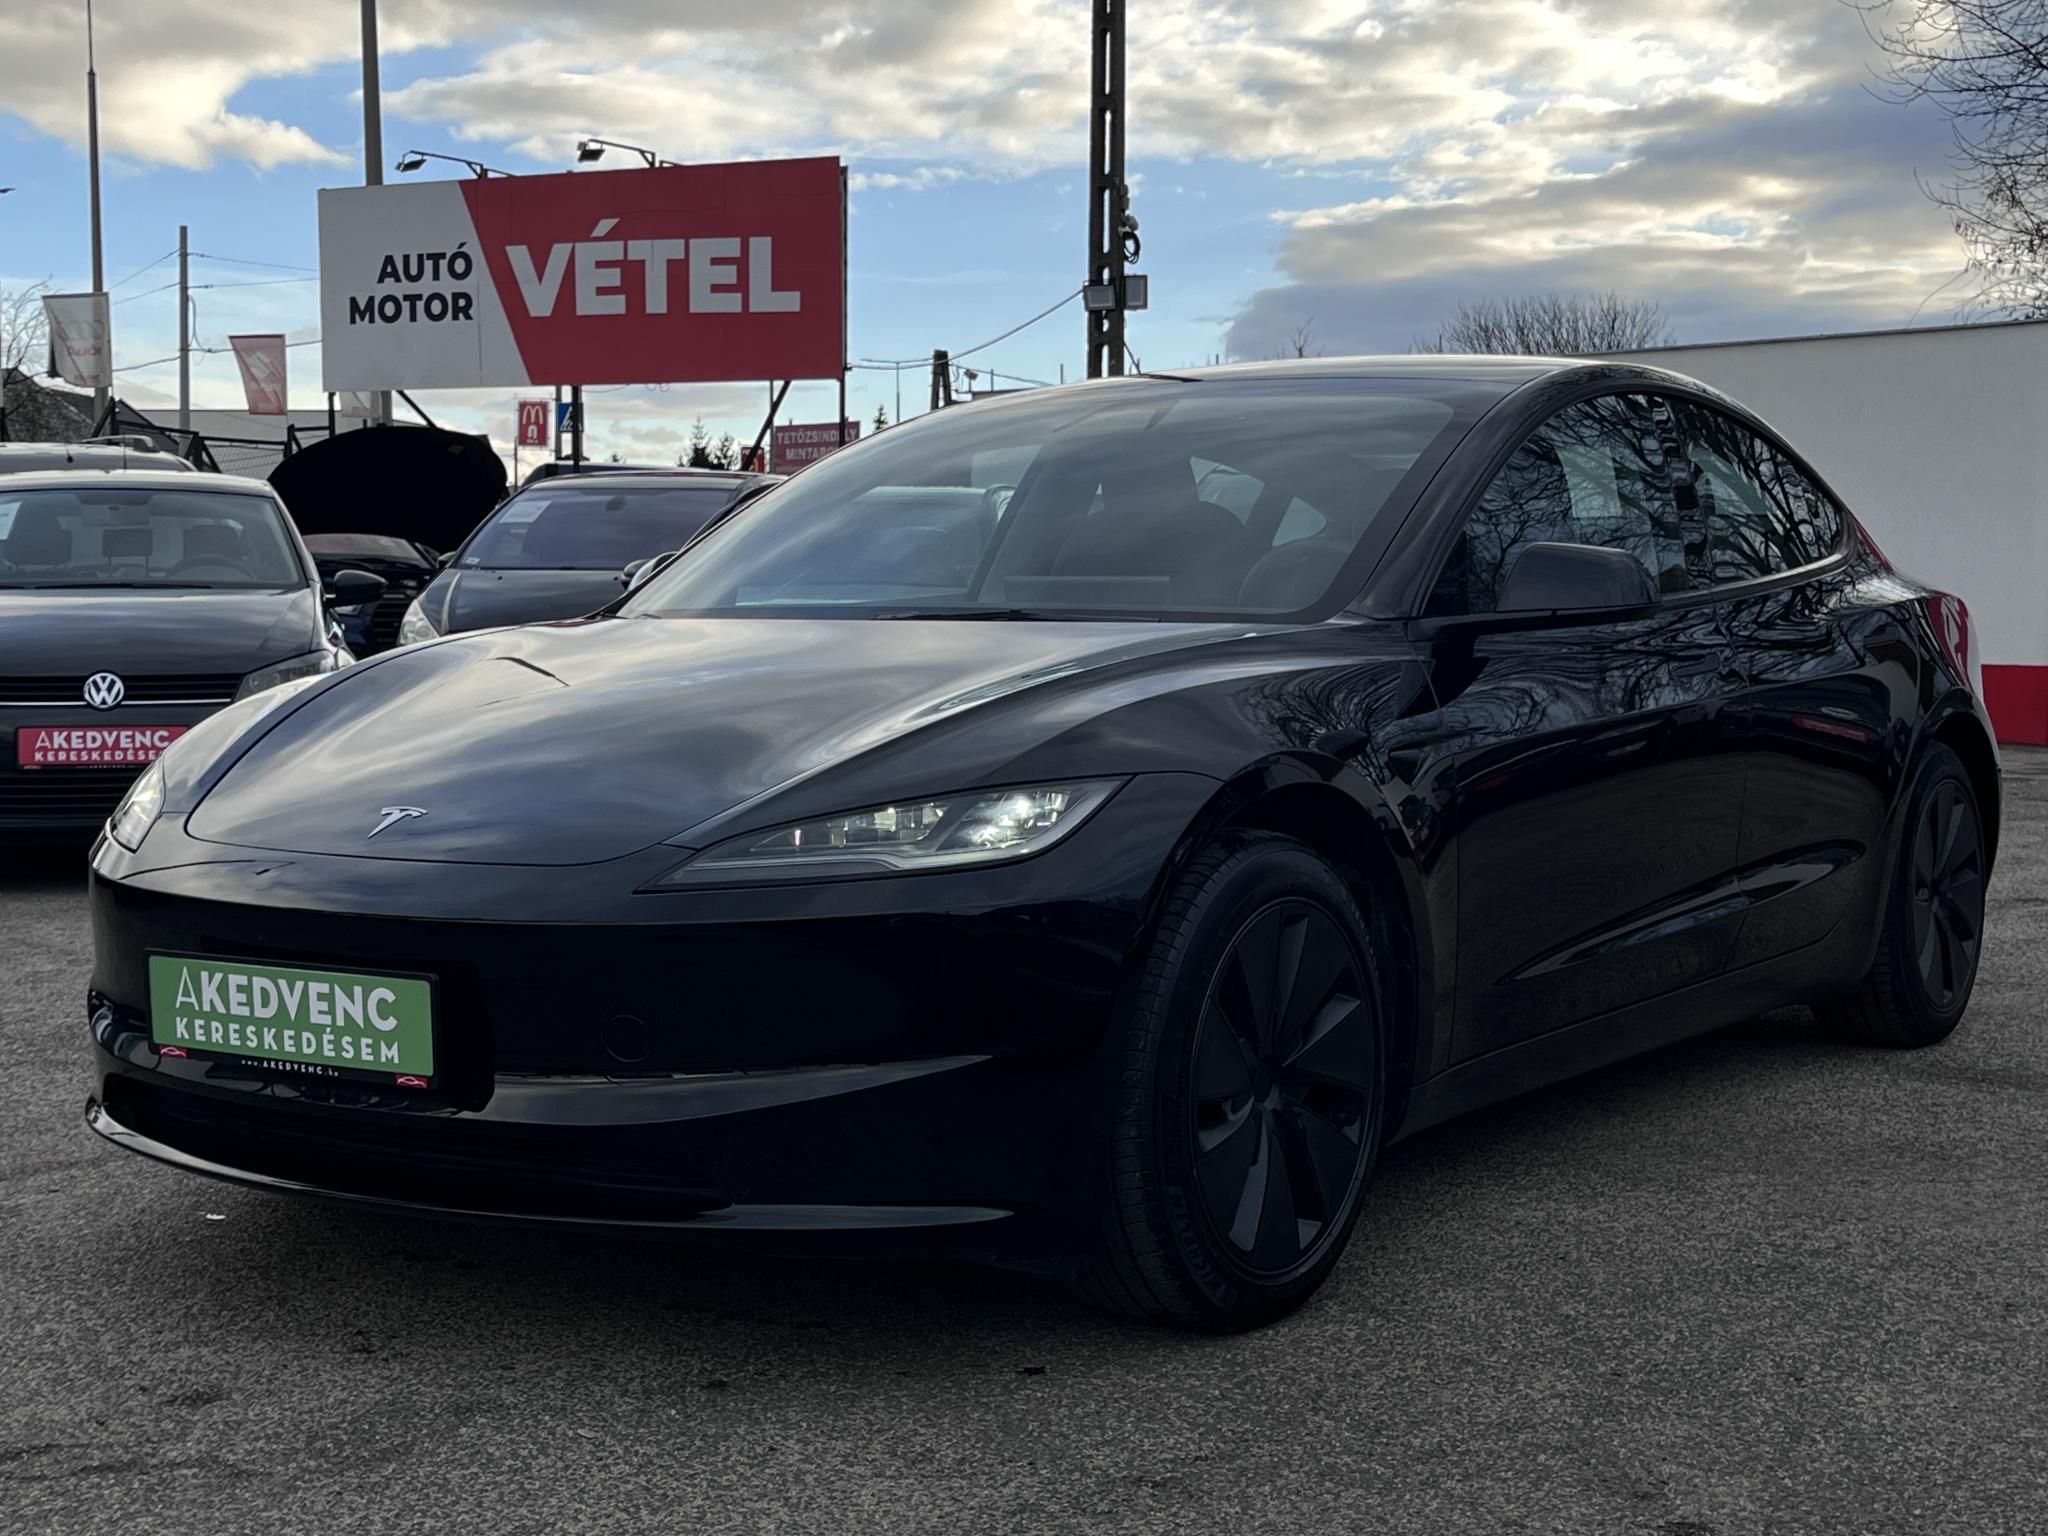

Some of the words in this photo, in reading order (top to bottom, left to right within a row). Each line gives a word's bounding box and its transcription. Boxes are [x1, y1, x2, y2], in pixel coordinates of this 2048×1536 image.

[377, 242, 474, 285] AUTÓ
[505, 218, 801, 317] VÉTEL
[349, 291, 474, 325] MOTOR
[776, 428, 858, 445] TETŐZSINDLY
[785, 446, 837, 461] MINTABO
[34, 730, 170, 749] AKEDVENC
[34, 746, 162, 762] KERESKEDÉSE
[175, 965, 399, 1032] AKEDVENC
[175, 1015, 401, 1065] KERESKEDÉSEM
